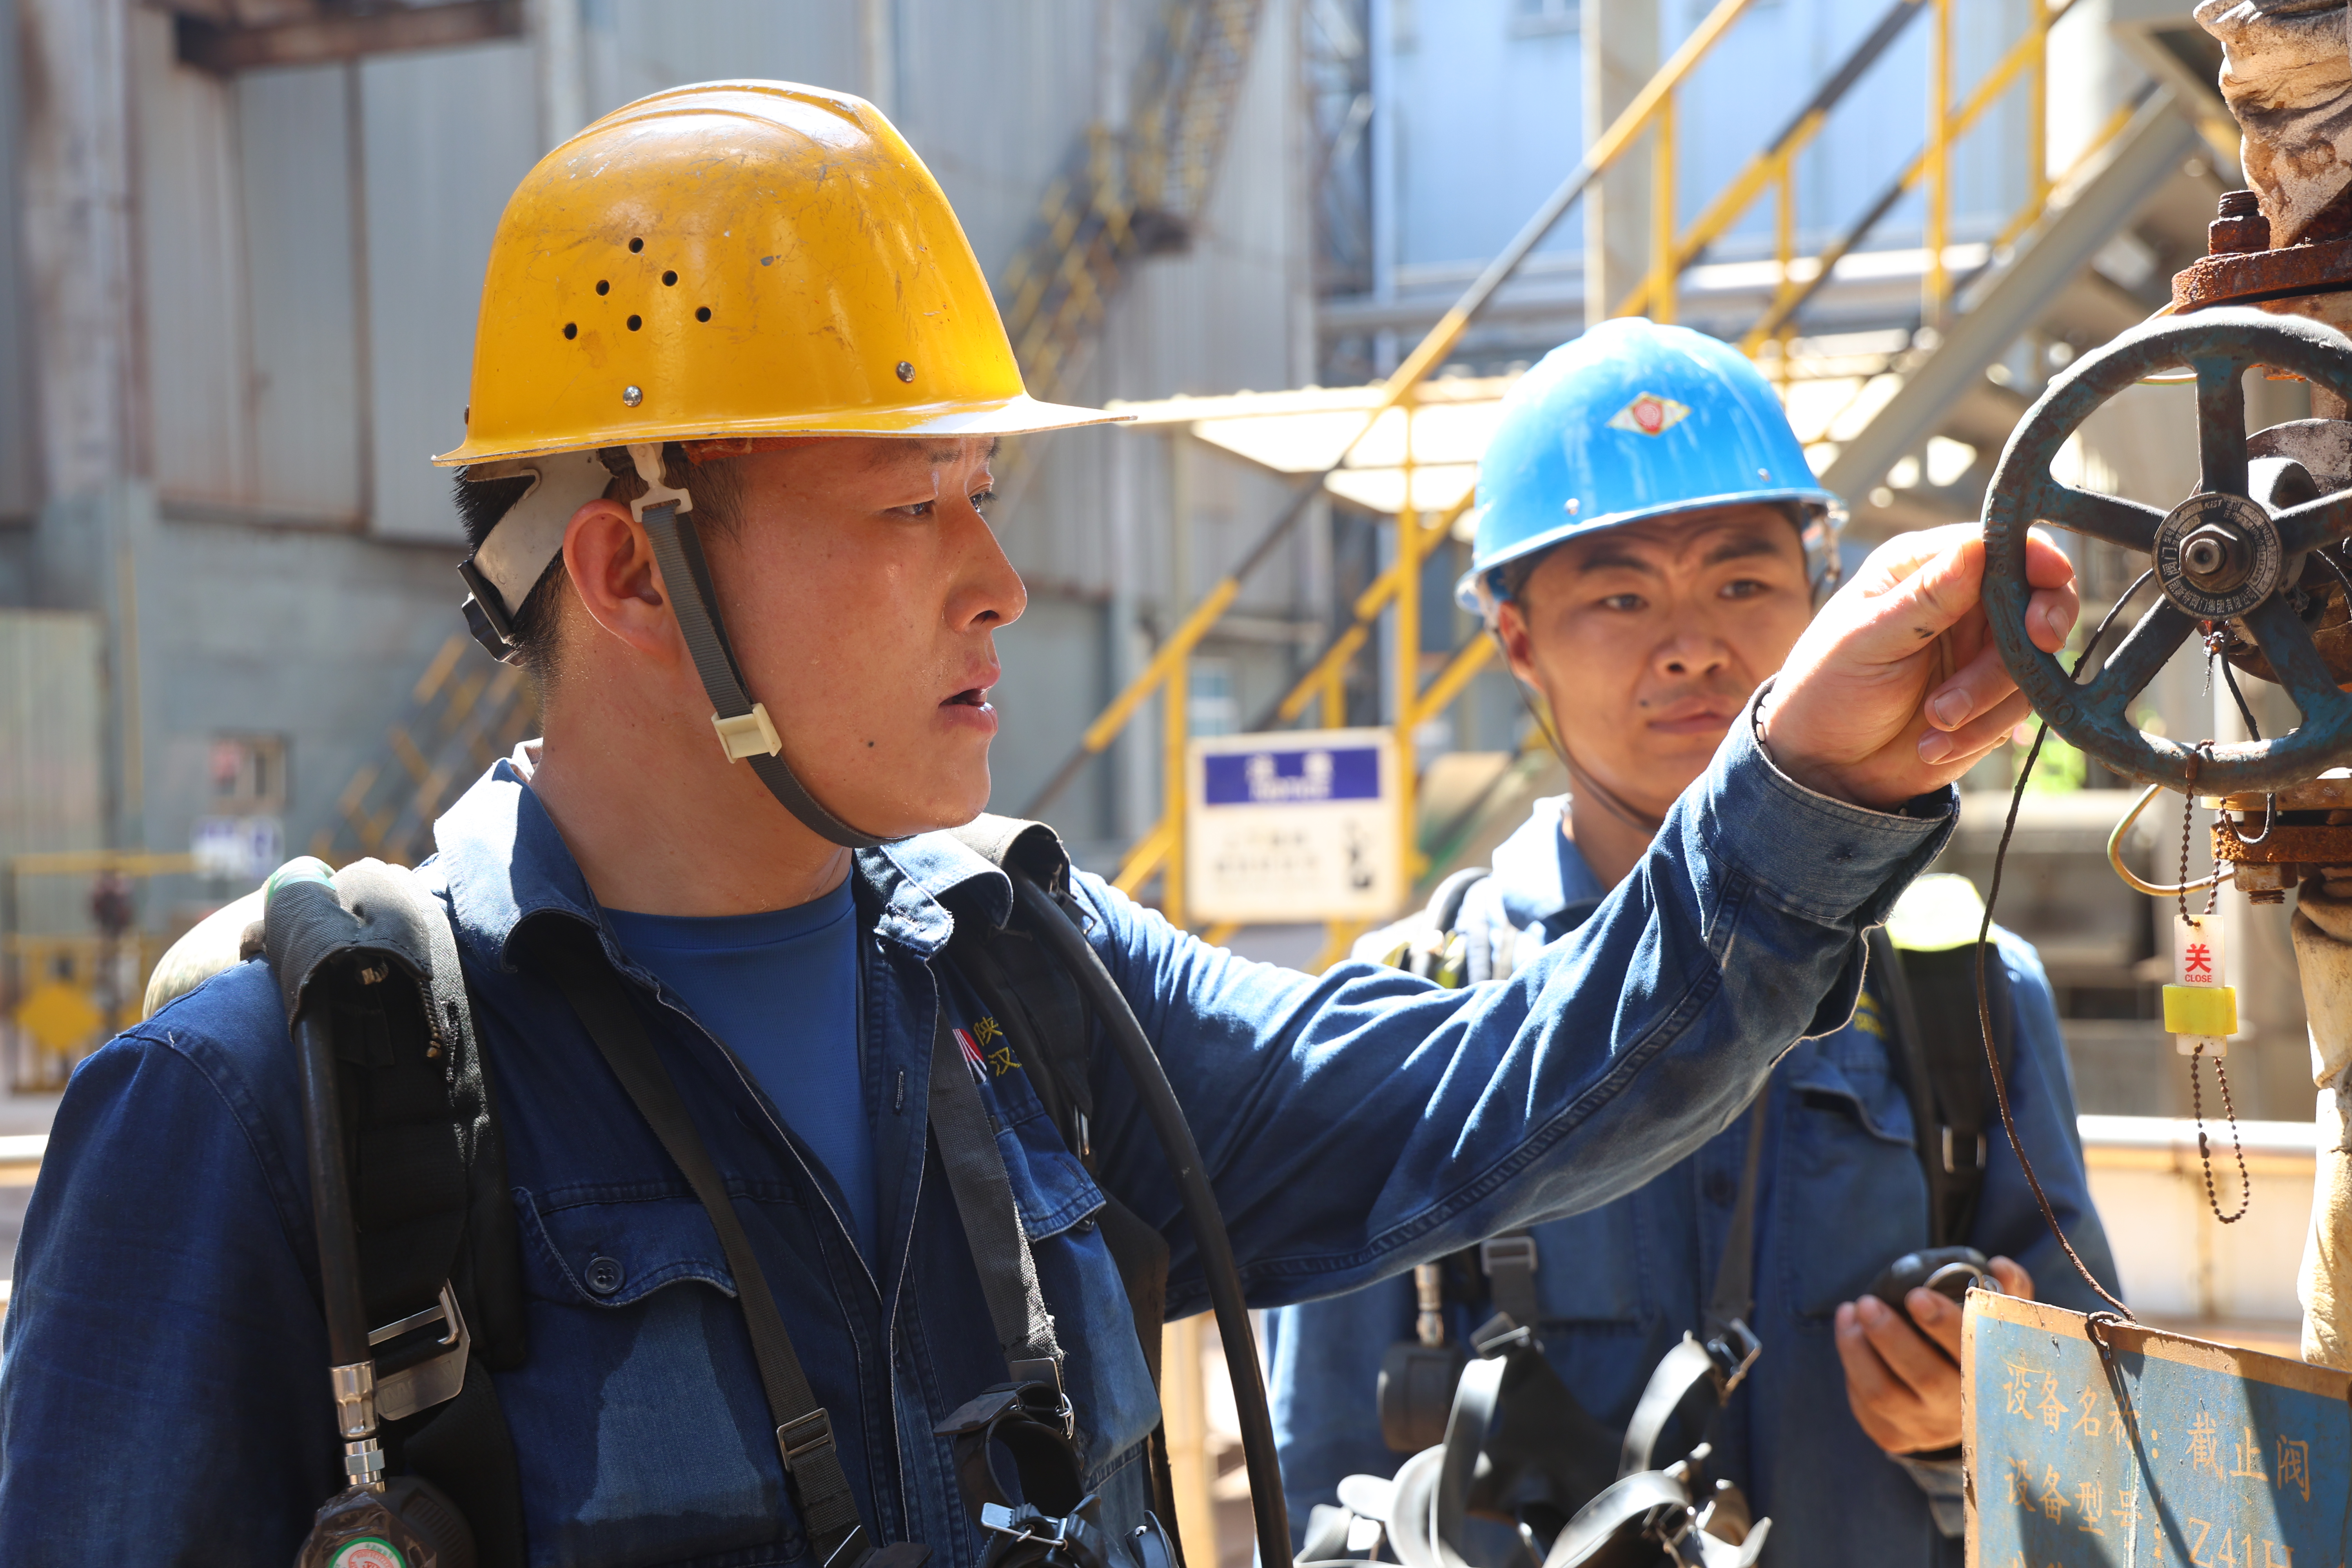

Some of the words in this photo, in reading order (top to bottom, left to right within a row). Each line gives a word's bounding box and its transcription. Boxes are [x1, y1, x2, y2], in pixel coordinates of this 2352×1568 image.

[2161, 546, 2180, 575] 阀门
[2185, 944, 2212, 973] 关
[2185, 974, 2212, 983] CLOSE
[2185, 1412, 2310, 1503] 截止阀
